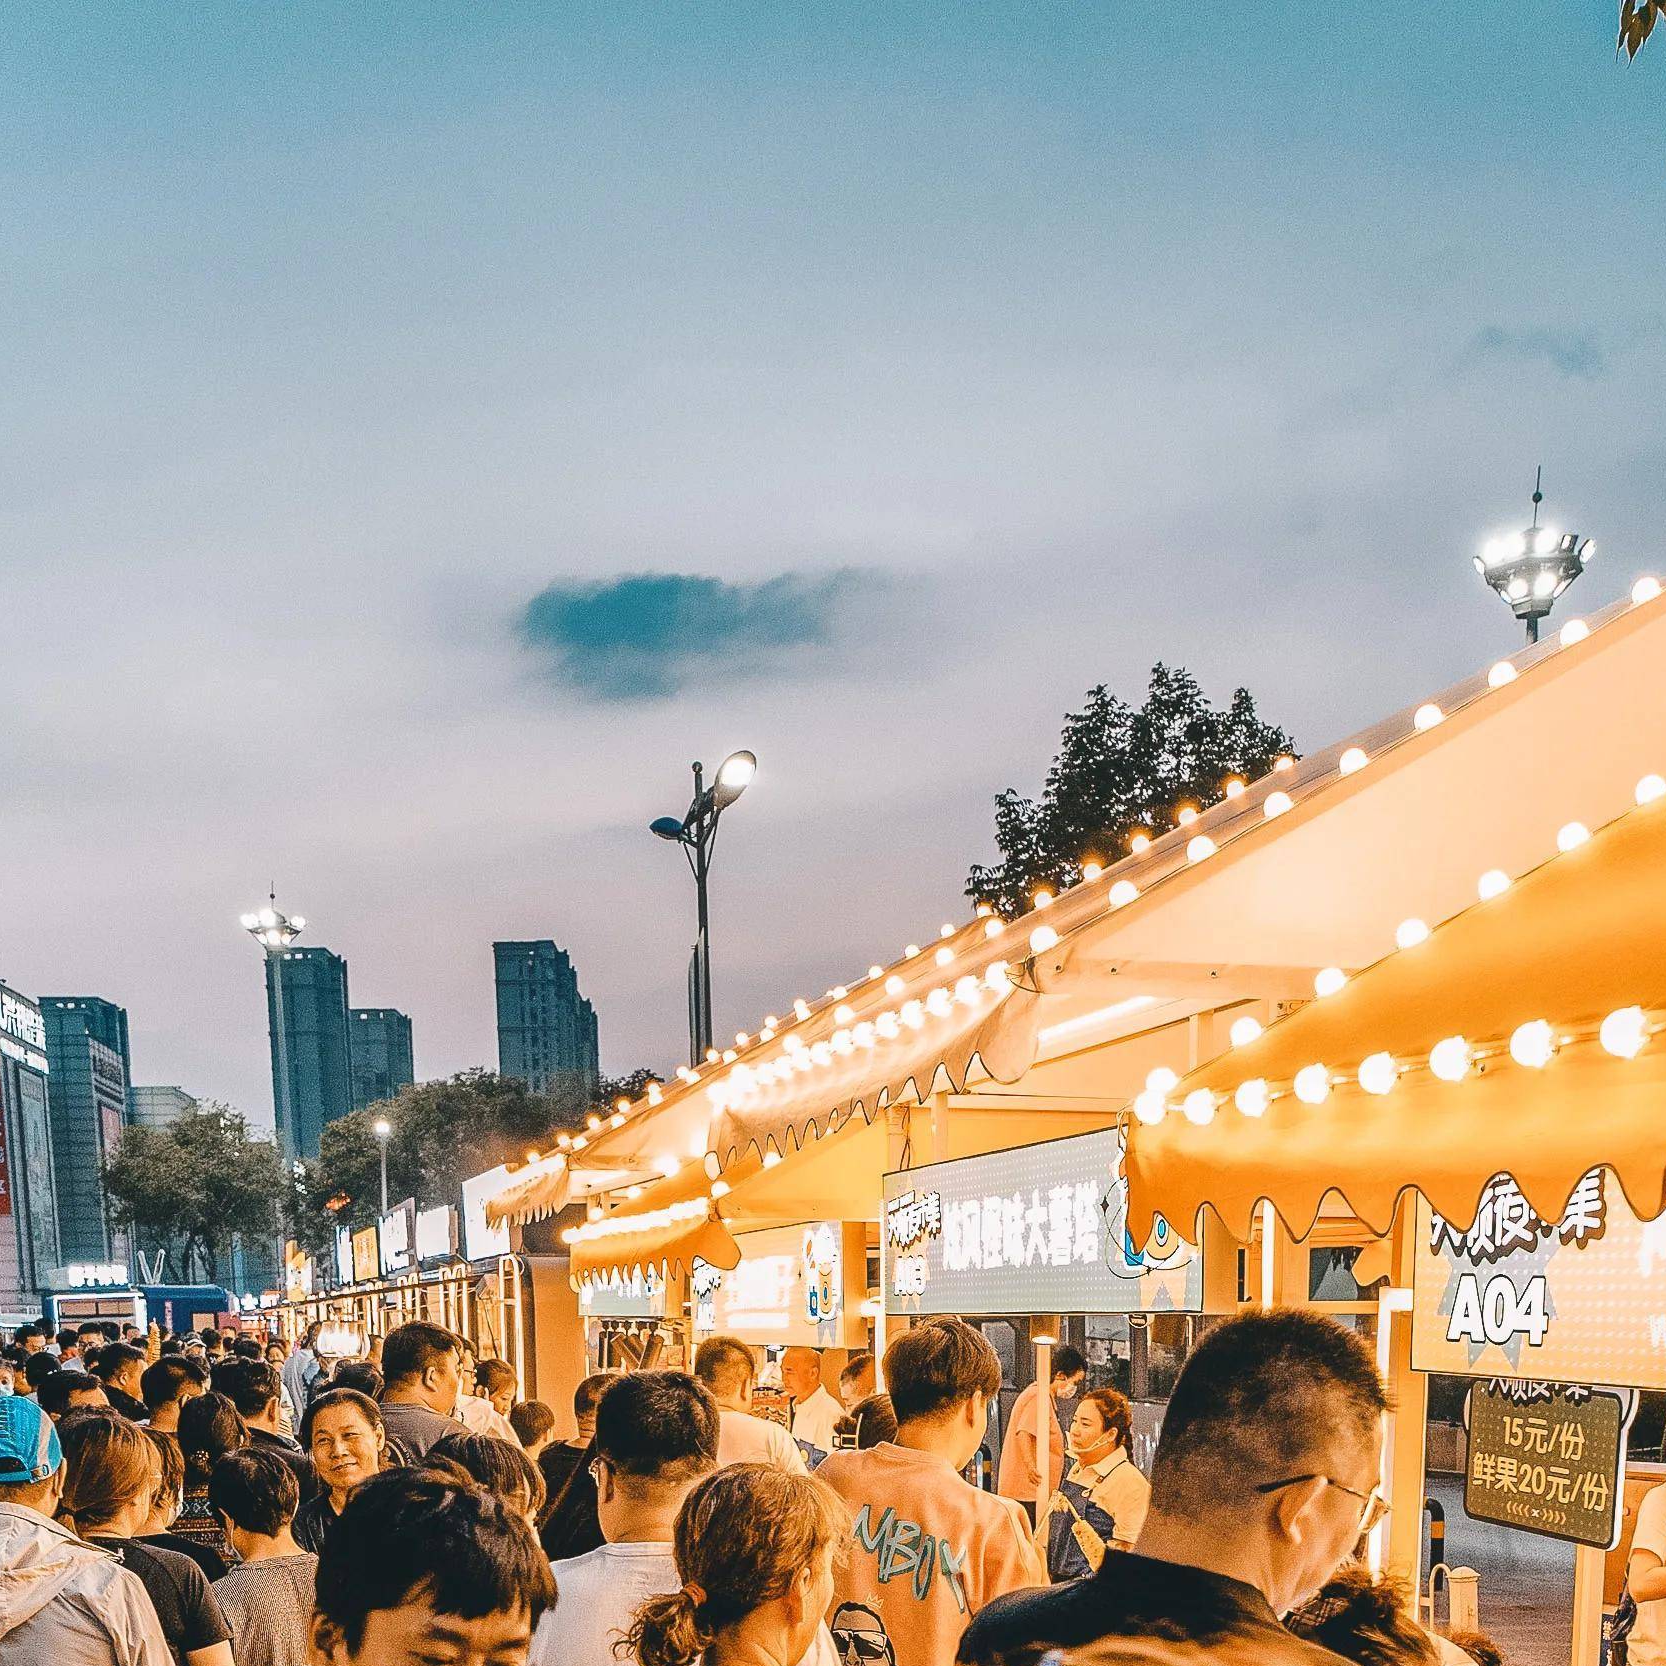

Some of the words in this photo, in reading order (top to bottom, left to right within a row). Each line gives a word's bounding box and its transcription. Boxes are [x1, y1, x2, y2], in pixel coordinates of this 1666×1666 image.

[1446, 1273, 1548, 1346] A04
[1503, 1416, 1585, 1461] 15元/份
[1472, 1451, 1609, 1512] 鲜果20元/份
